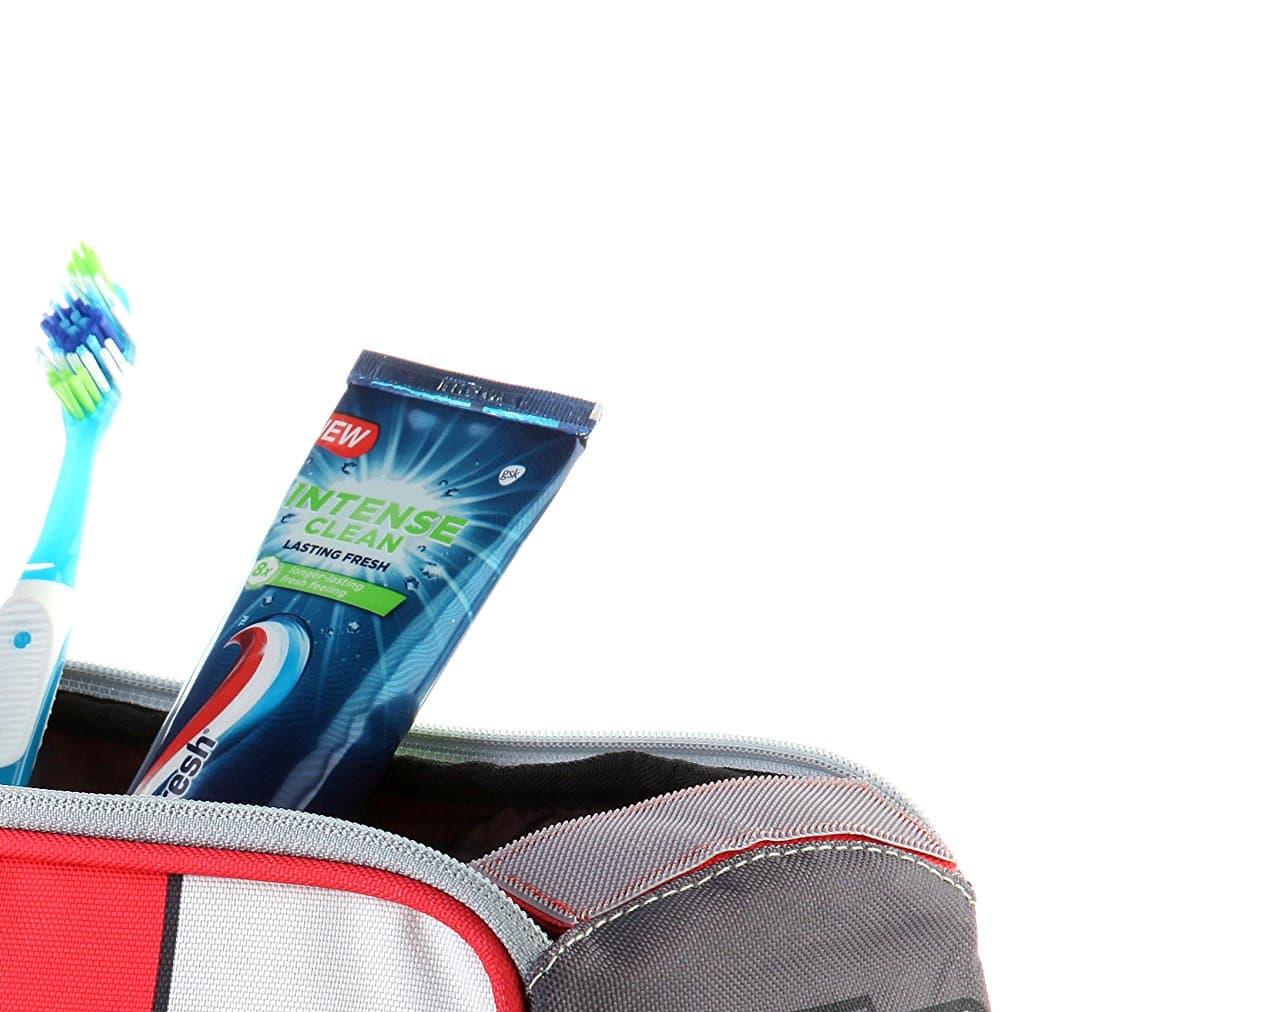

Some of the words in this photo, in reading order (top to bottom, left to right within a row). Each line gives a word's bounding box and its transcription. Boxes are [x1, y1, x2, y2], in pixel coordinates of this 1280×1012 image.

[282, 483, 469, 544] INTENSE
[304, 517, 404, 553] CLEAN
[282, 539, 342, 560] LASTING
[342, 552, 391, 572] FRESH
